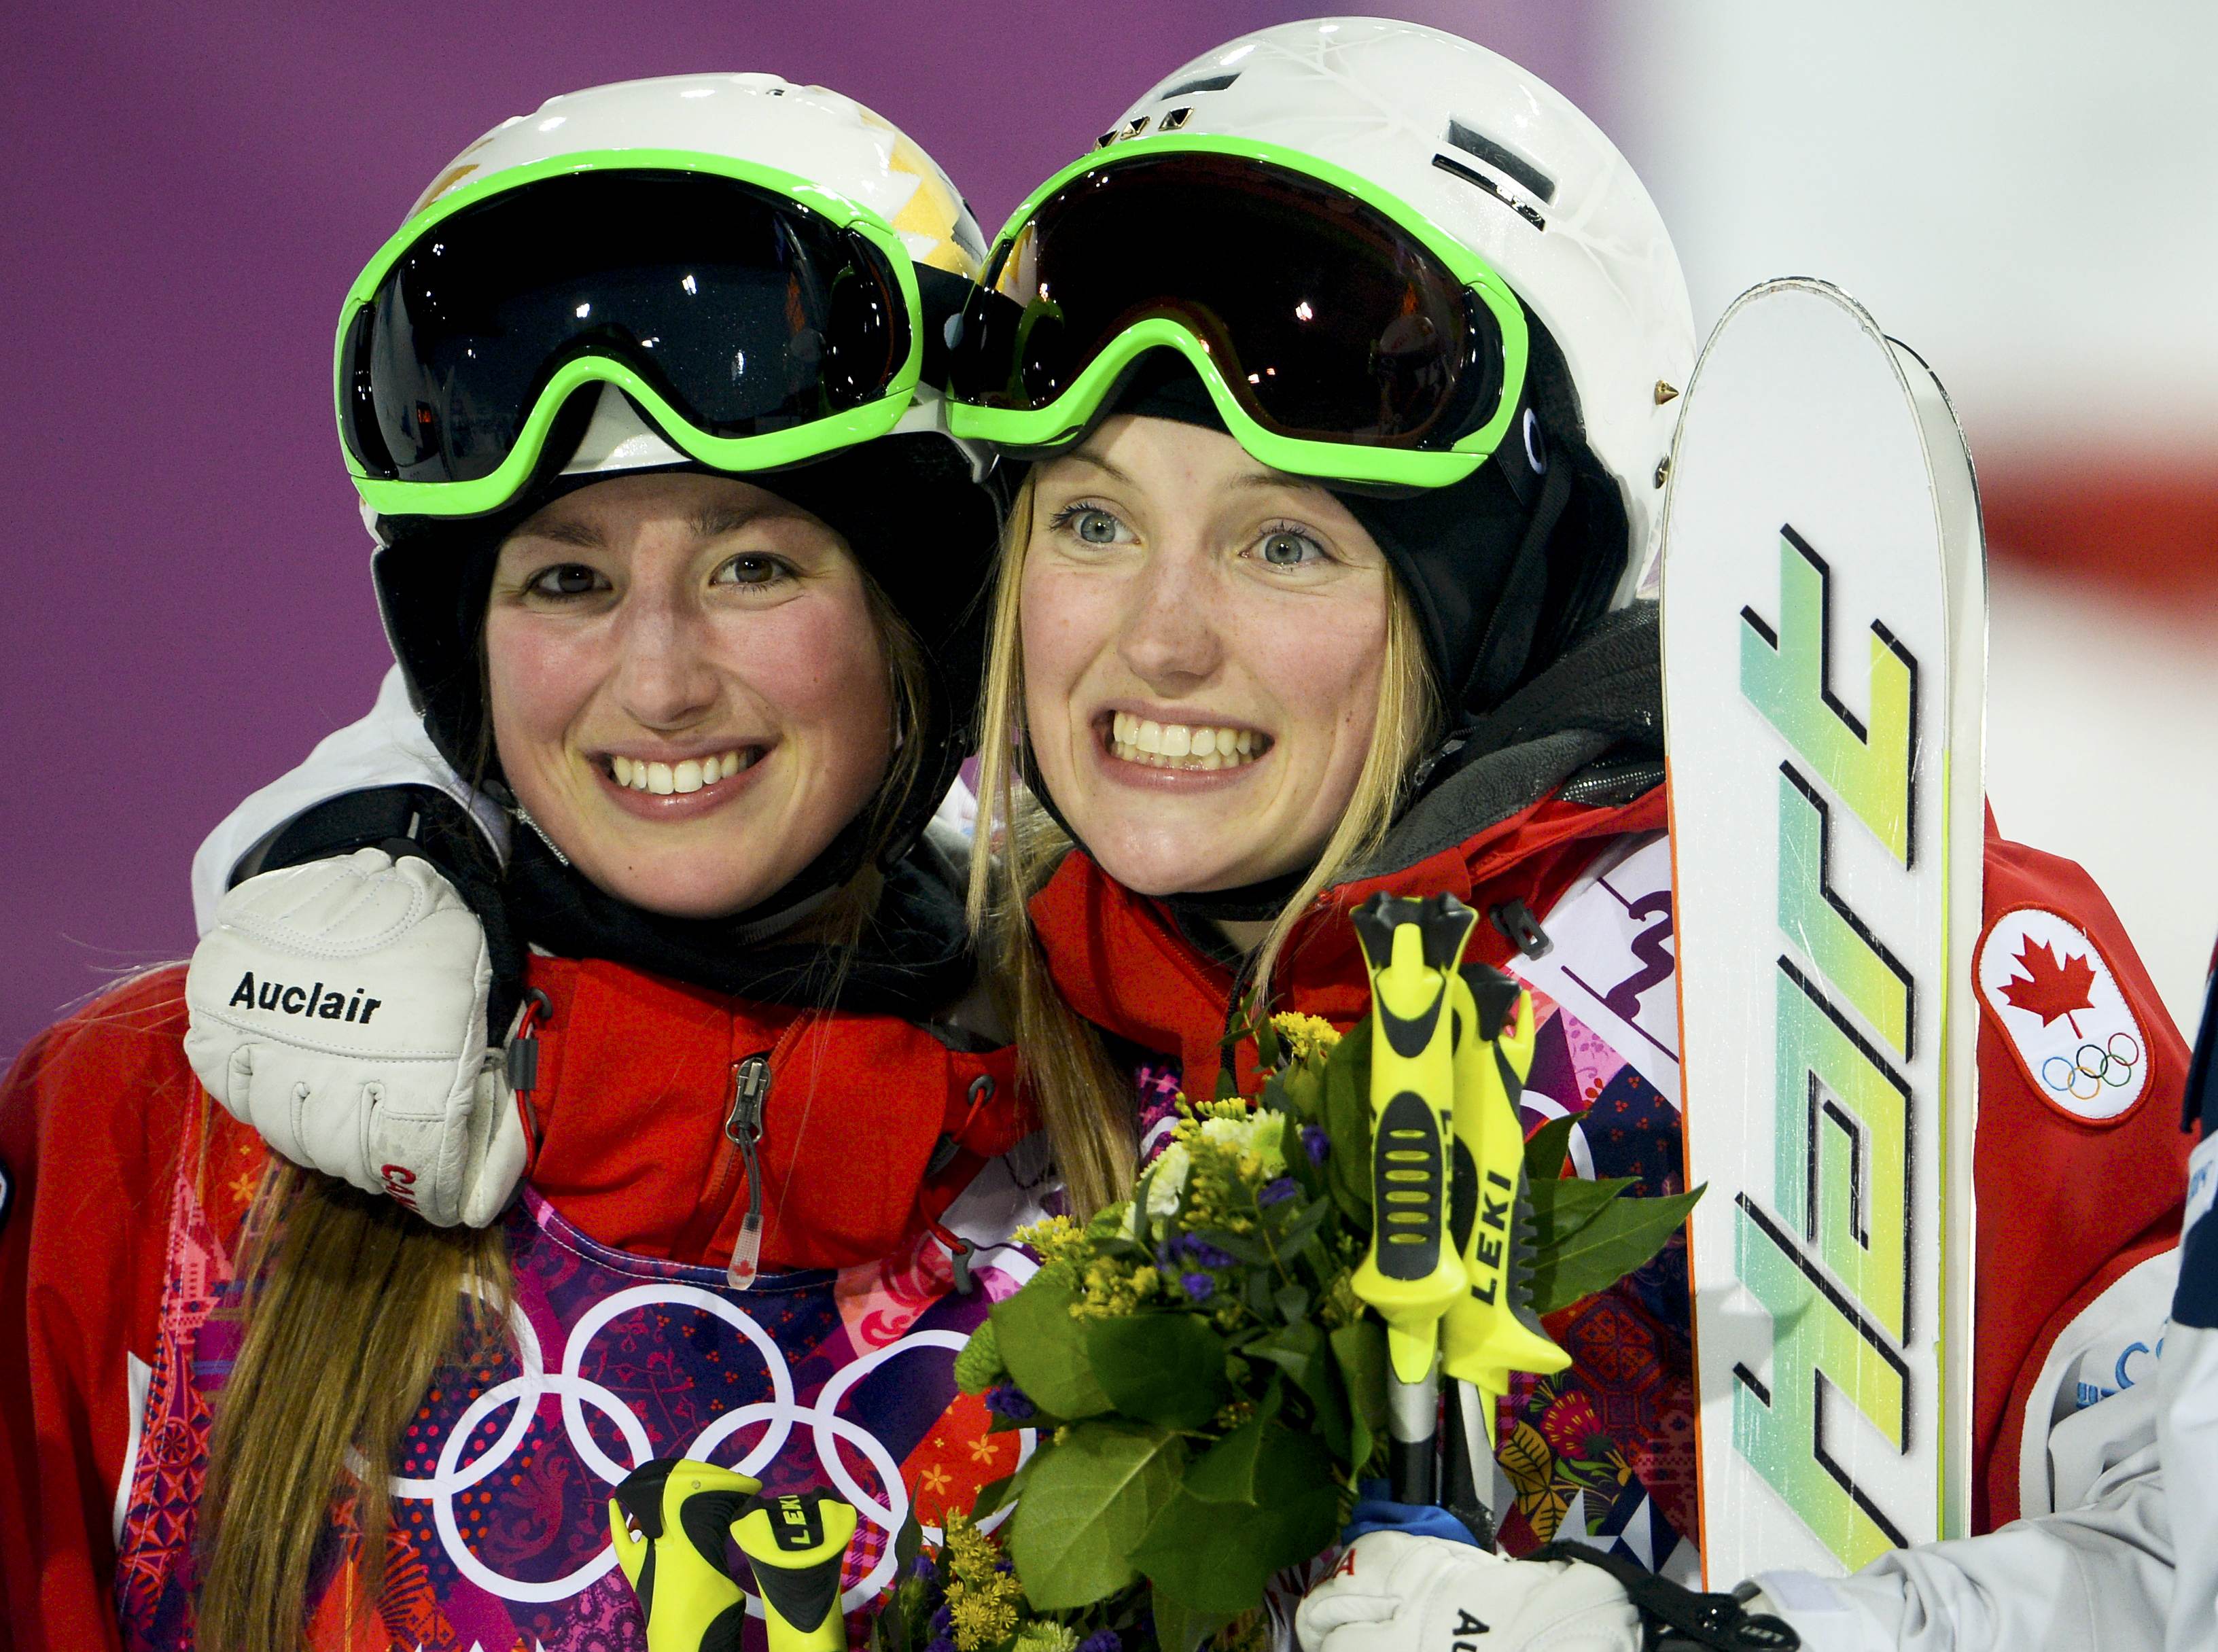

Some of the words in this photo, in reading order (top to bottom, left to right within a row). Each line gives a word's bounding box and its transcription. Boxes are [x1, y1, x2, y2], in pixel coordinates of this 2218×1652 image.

[229, 971, 382, 1024] Auclair
[1471, 1170, 1511, 1306] LEKI
[778, 1495, 811, 1545] LEKI
